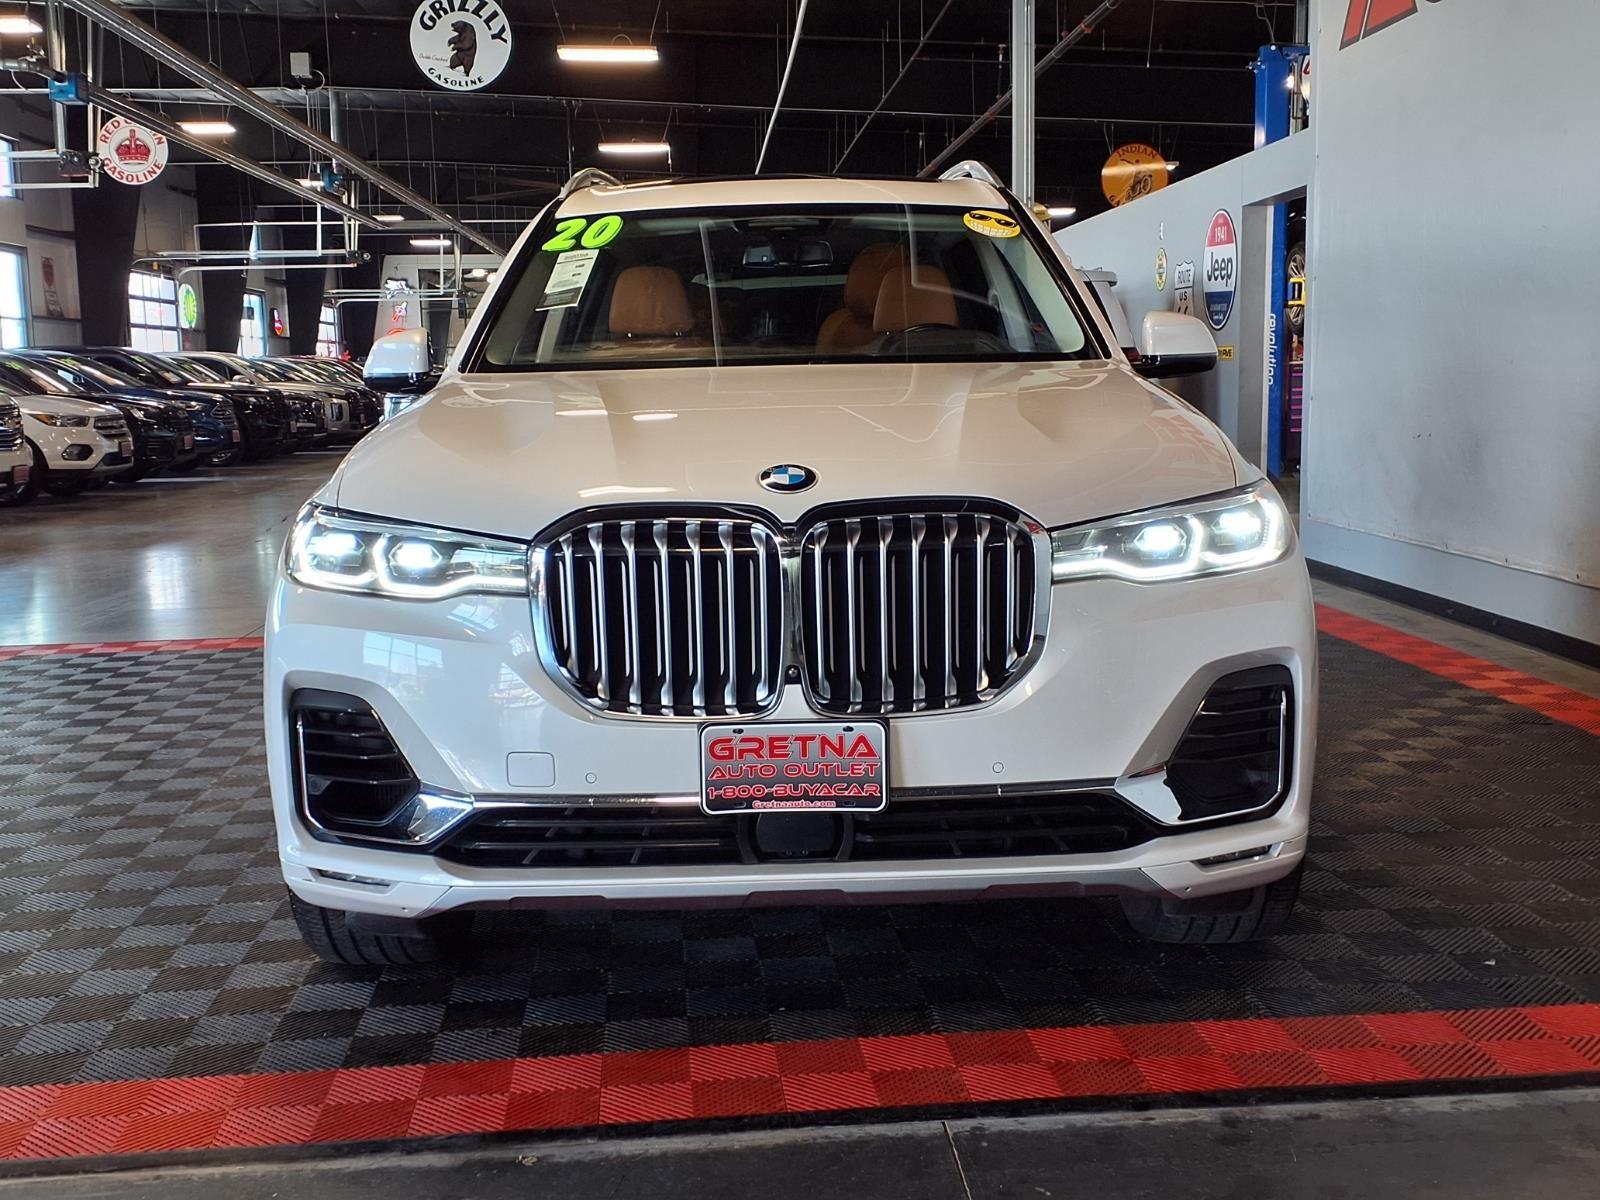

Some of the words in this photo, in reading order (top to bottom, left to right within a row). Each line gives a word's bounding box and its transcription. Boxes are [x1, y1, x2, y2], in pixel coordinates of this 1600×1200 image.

[420, 0, 507, 44] GRIZZLY
[428, 67, 484, 87] GASOLINE
[100, 120, 120, 144] RED
[1116, 145, 1157, 159] INDIAN
[103, 157, 163, 183] GASOLINE
[541, 215, 623, 251] 20
[1215, 225, 1227, 243] 1941
[1207, 251, 1233, 287] Jeep
[707, 733, 880, 761] GRETNA
[707, 764, 777, 780] AUTO
[783, 762, 881, 778] OUTLET
[707, 783, 881, 799] 1-800-BUYACAR
